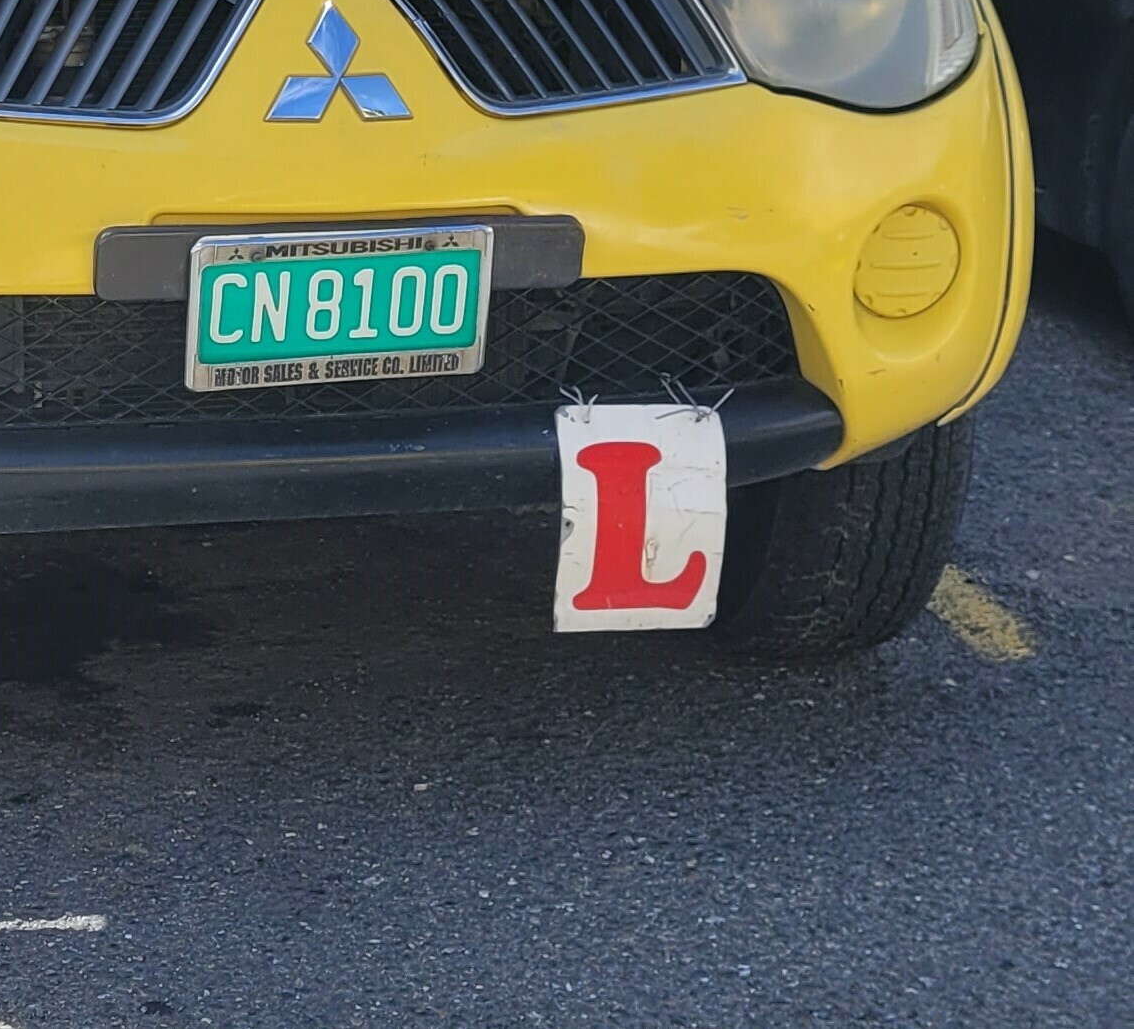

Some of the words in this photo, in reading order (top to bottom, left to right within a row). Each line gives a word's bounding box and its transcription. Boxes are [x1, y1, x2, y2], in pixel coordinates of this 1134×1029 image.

[266, 236, 423, 259] MITSUBISHI
[209, 271, 291, 344] CN
[305, 264, 468, 341] 8100
[263, 362, 303, 383] SALES
[308, 362, 320, 380] &
[324, 356, 379, 379] SERVICE
[382, 357, 405, 376] CO.
[410, 353, 460, 374] LIMITED
[572, 441, 707, 611] L
